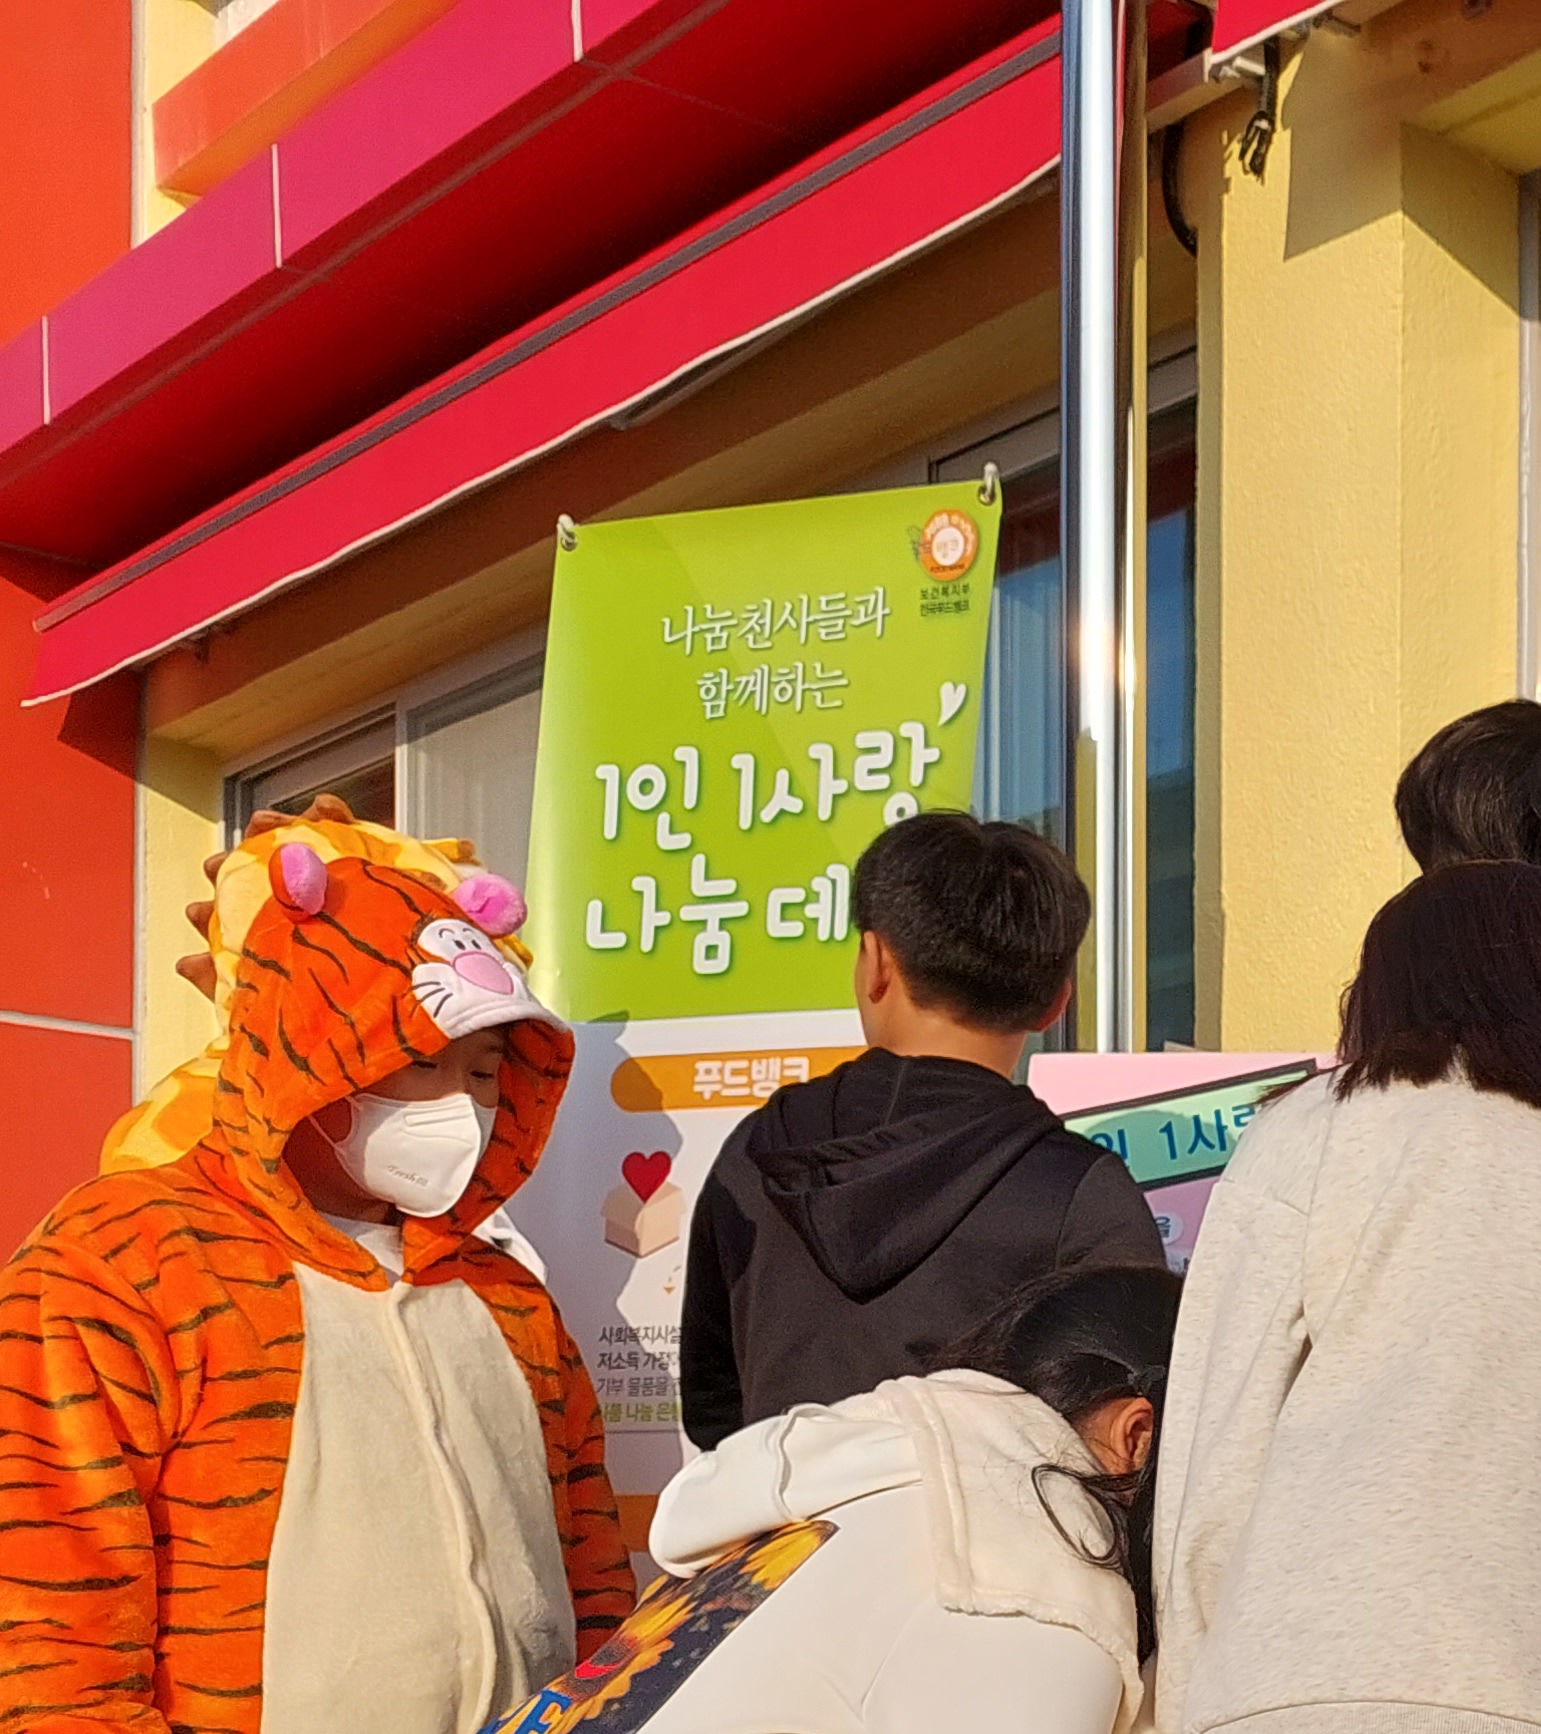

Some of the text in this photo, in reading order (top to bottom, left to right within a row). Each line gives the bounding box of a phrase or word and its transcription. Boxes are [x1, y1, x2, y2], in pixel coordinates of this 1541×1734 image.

[697, 661, 848, 719] 함께하는
[595, 746, 699, 850] 1인
[586, 853, 749, 974] 나눔
[597, 1351, 677, 1371] 저소득 가정
[597, 1378, 623, 1396] 기부
